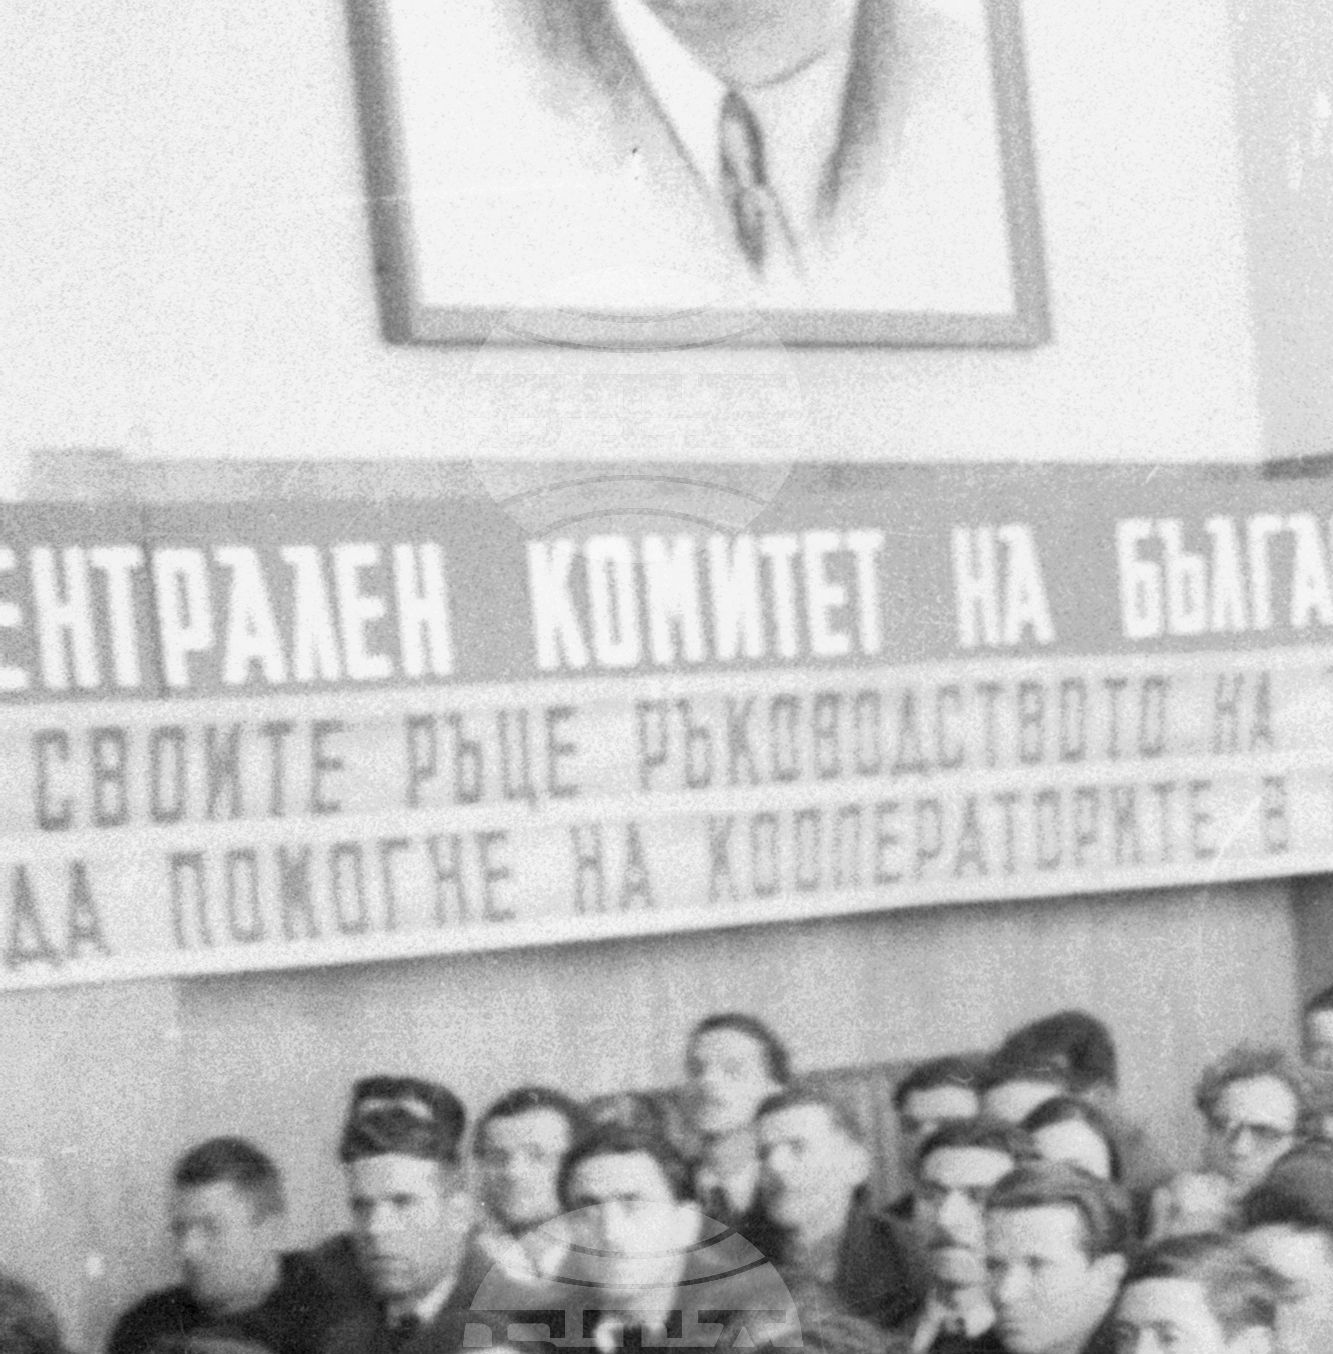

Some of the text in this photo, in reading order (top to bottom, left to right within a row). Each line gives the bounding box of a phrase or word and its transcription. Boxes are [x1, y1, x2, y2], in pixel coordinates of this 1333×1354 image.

[527, 529, 885, 671] КОМИТЕТ
[951, 524, 1055, 648] НА
[32, 721, 346, 832] СВОИТЕ
[405, 704, 579, 811] РЪЦЕ
[636, 676, 1170, 793] РЪКОВОДСТВОТО
[1213, 671, 1275, 756] НА
[5, 859, 110, 970] ДА
[571, 820, 658, 916] НА
[706, 779, 1216, 905] КООПЕРАТОРИТЕ
[1261, 774, 1289, 855] В
